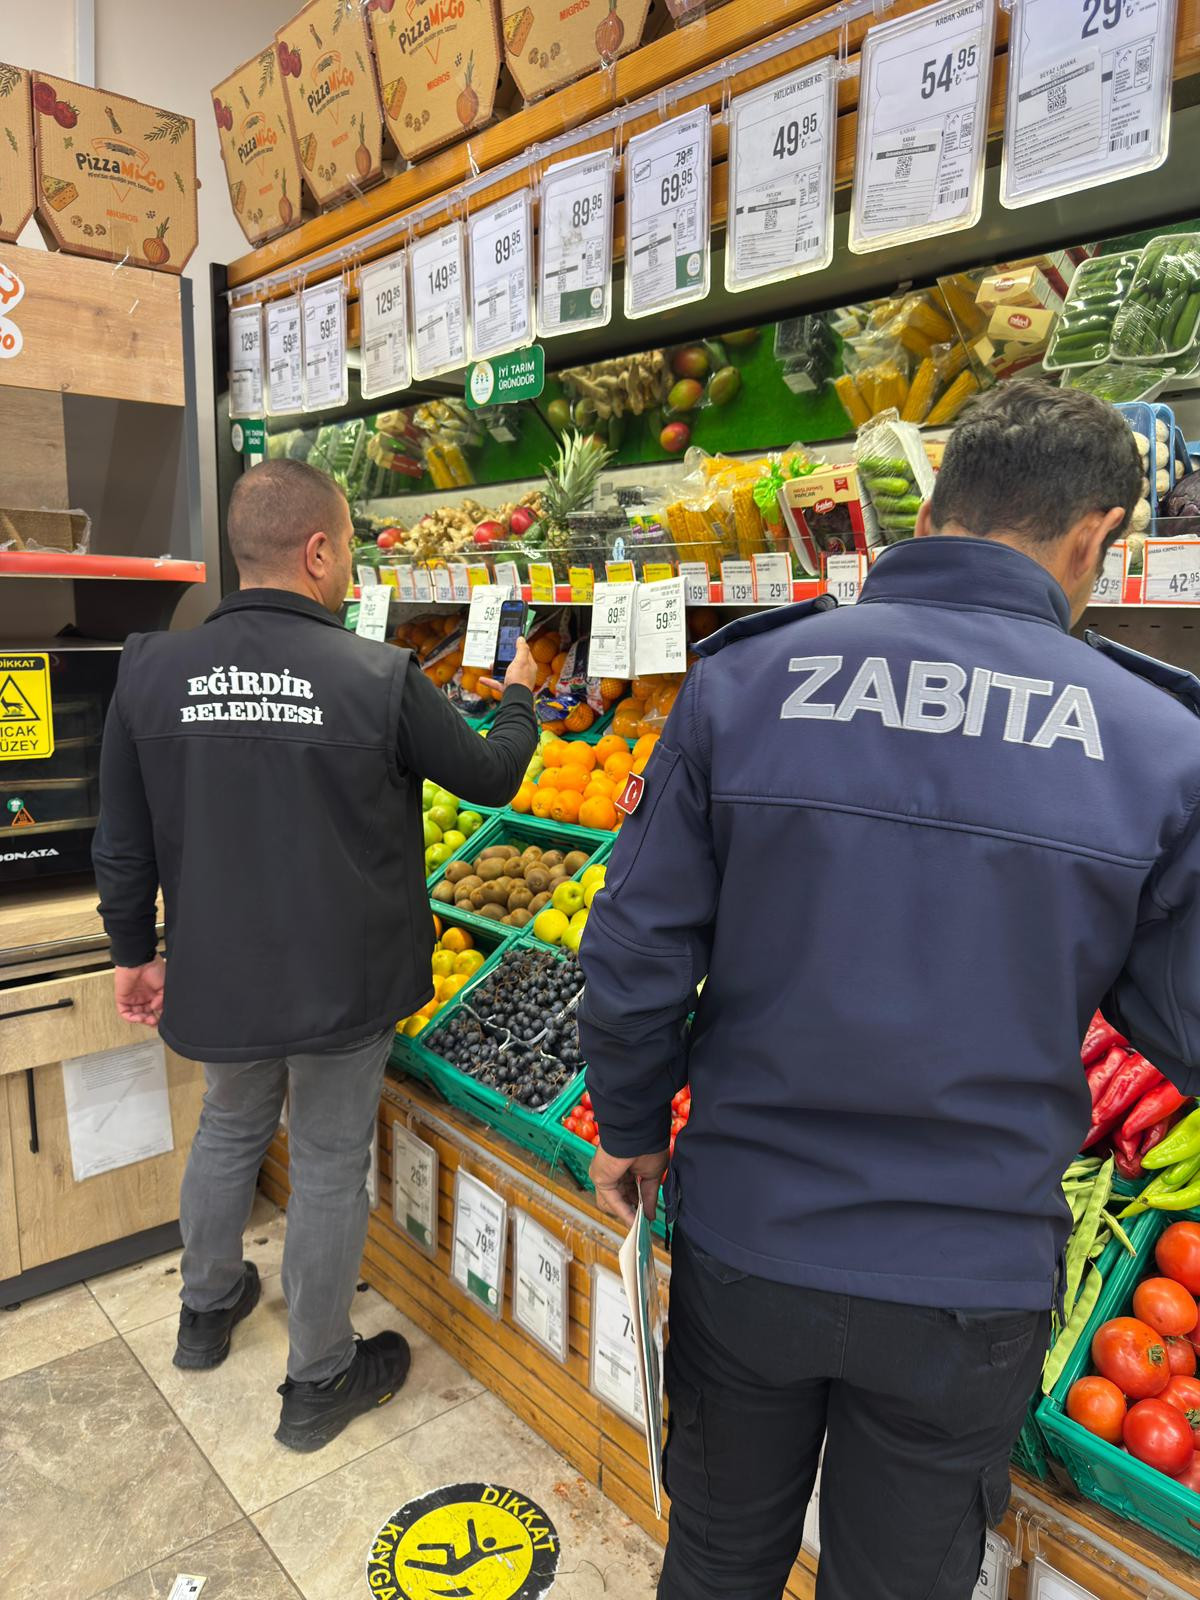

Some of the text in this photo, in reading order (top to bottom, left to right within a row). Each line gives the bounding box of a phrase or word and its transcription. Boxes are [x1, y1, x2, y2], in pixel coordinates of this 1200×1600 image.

[560, 0, 591, 22] MIGROS
[1081, 0, 1126, 39] 29,
[921, 44, 977, 99] 54,95
[773, 83, 797, 102] PATLICAN
[773, 113, 818, 160] 49,95
[661, 168, 693, 206] 69,95
[573, 193, 603, 228] 89,95
[495, 229, 521, 265] 89,95
[428, 262, 458, 295] 149,95
[376, 285, 401, 316] 129,95
[498, 361, 535, 378] İYİ TARIM
[498, 374, 535, 391] ÜRÜNÜDÜR
[1169, 571, 1200, 594] 42,95
[656, 610, 678, 630] 59,95
[187, 665, 314, 700] EĞİRDİR
[179, 696, 324, 726] BELEDİYESİ
[779, 655, 1105, 762] ZABITA
[0, 725, 37, 738] ICAK
[0, 738, 39, 753] ÜZEY
[476, 1228, 495, 1253] 79,95
[538, 1253, 561, 1282] 79,95
[480, 1486, 556, 1554] DİKKAT
[368, 1522, 404, 1600] KAYGA
